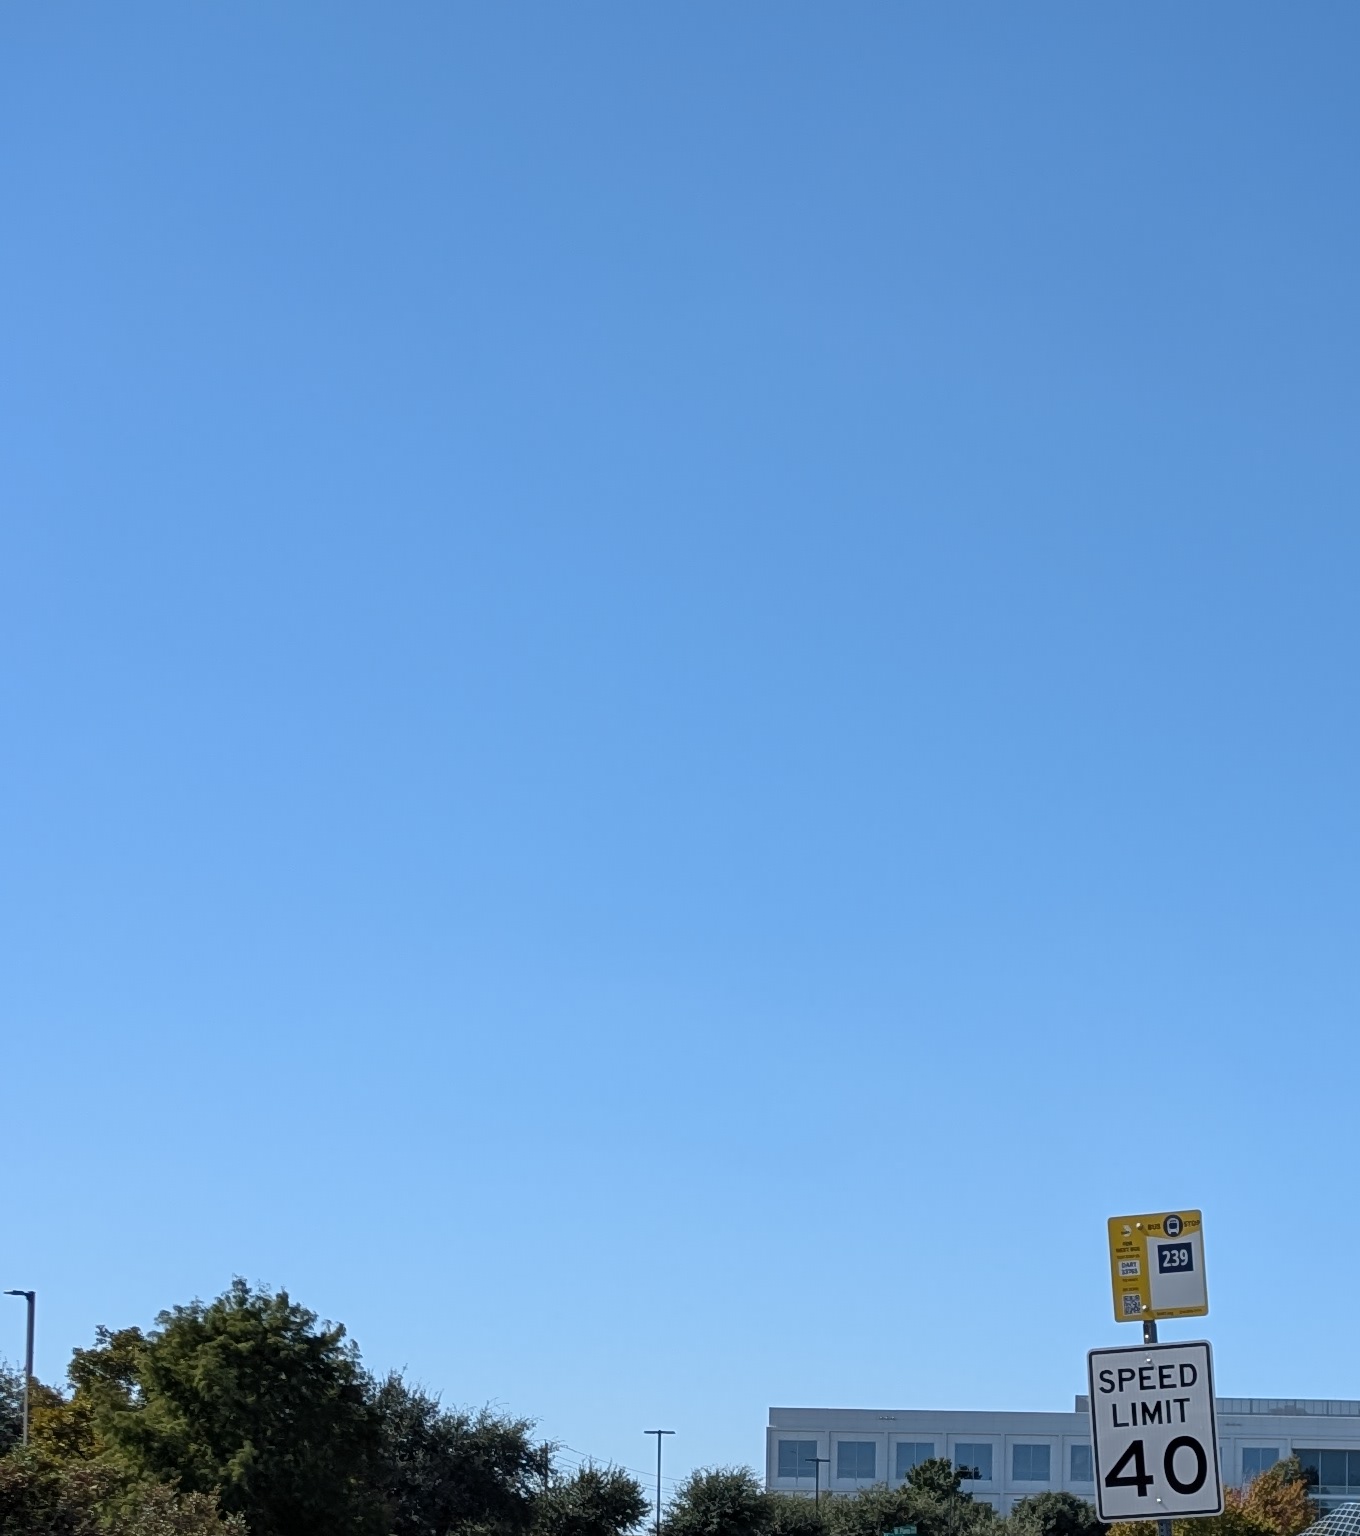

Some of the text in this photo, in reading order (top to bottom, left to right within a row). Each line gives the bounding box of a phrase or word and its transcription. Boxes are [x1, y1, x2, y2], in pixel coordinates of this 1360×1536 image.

[1184, 1219, 1200, 1228] STOP
[1162, 1249, 1189, 1268] 239
[1099, 1363, 1198, 1394] SPEED
[1112, 1398, 1191, 1428] LIMIT
[1105, 1435, 1208, 1497] 40
